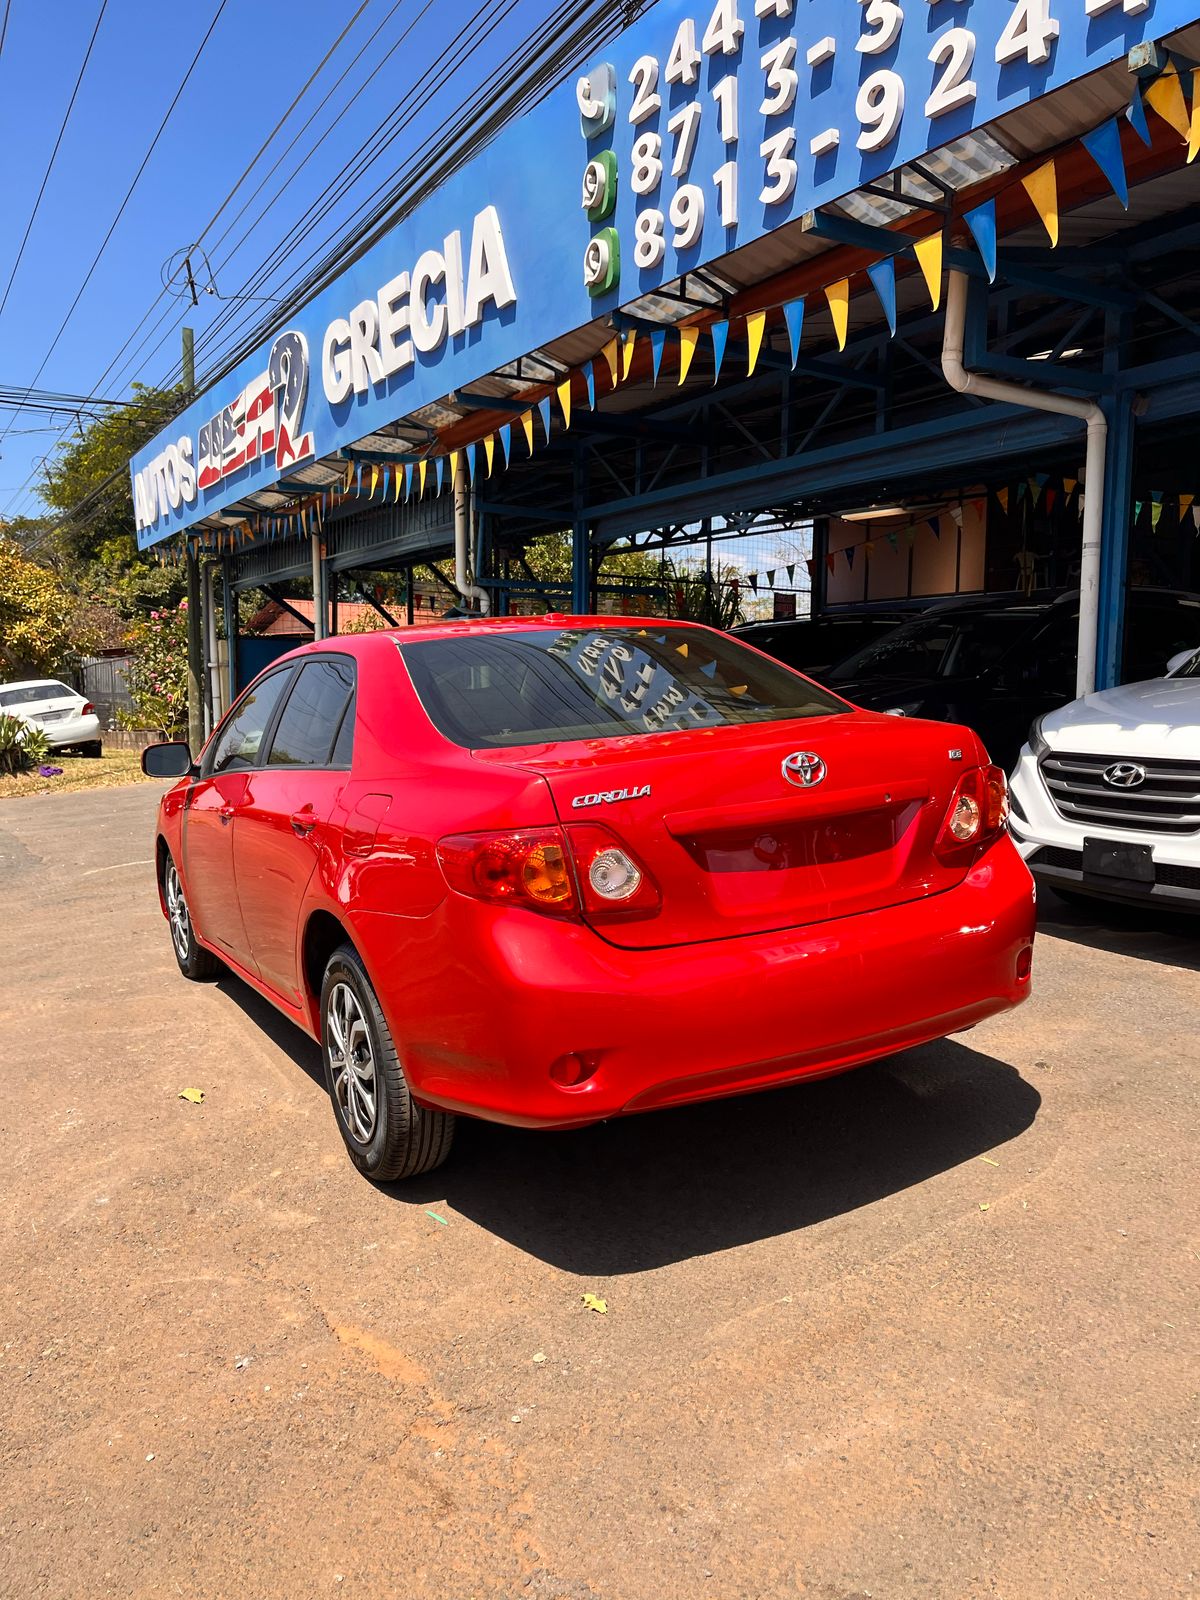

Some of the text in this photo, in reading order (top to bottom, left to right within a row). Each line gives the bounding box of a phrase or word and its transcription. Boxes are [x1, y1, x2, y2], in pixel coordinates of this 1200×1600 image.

[628, 0, 793, 125] 244
[631, 0, 967, 195] 8713-3
[634, 0, 1149, 269] 8913-924
[134, 436, 196, 530] AUTOS
[322, 205, 517, 404] GRECIA
[571, 784, 652, 808] COROLLA
